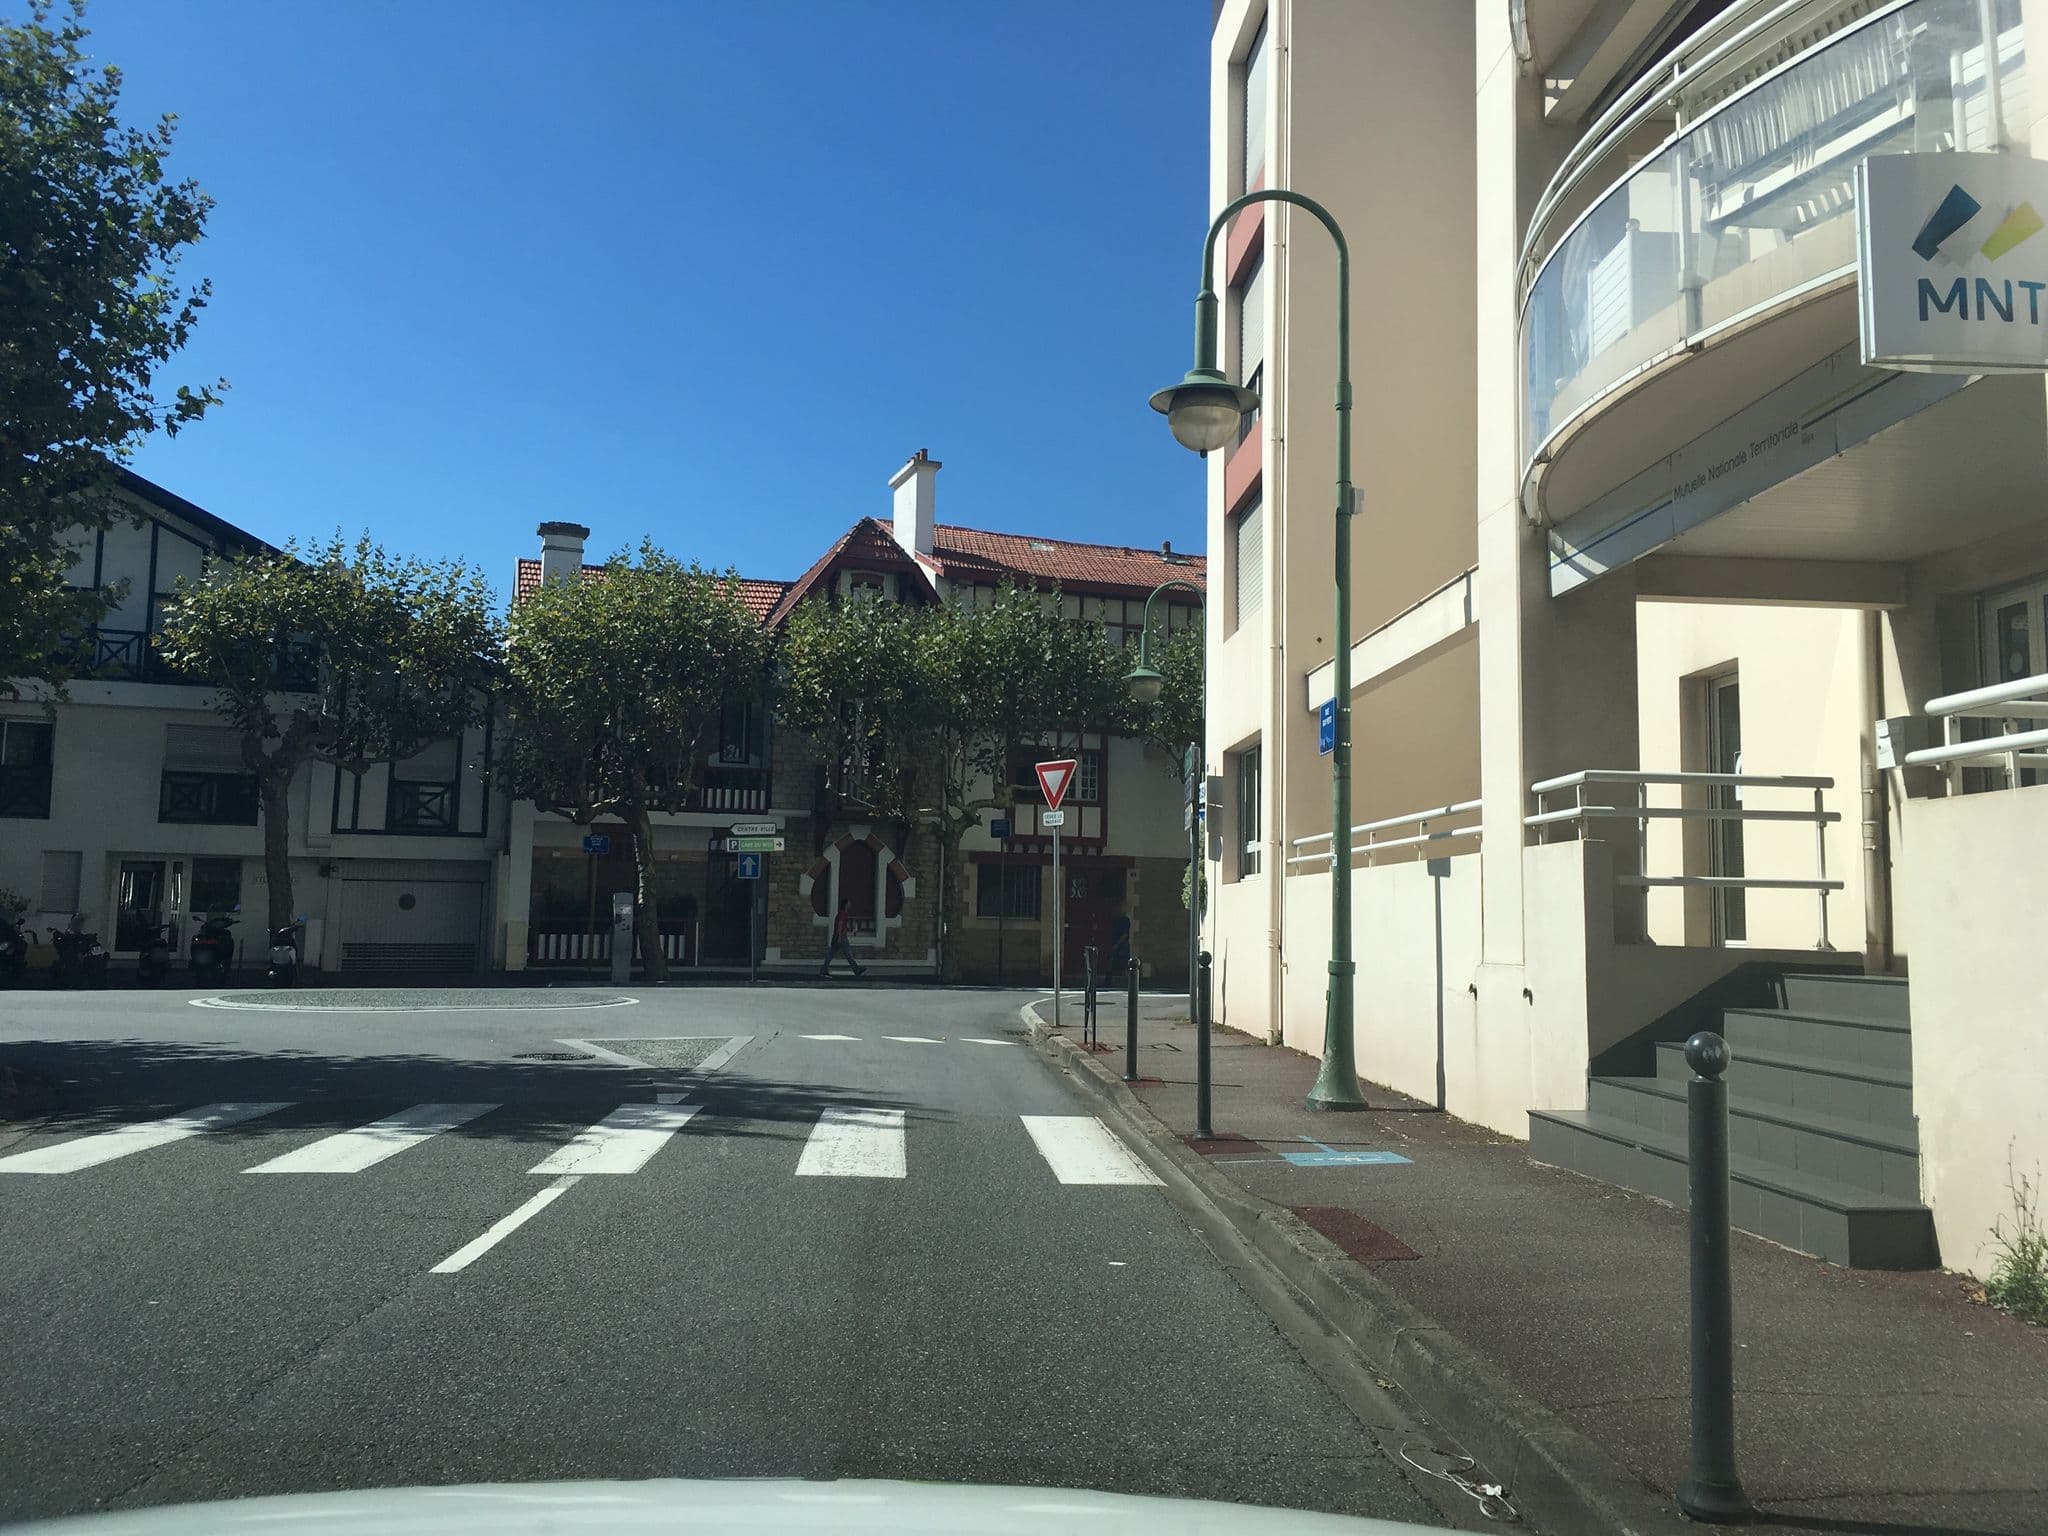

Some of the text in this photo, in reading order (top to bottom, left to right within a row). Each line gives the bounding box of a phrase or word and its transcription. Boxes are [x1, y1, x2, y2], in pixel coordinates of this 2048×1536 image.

[1918, 277, 2046, 324] MNT
[1673, 421, 1799, 500] Mutuelle Nationale Territoriale
